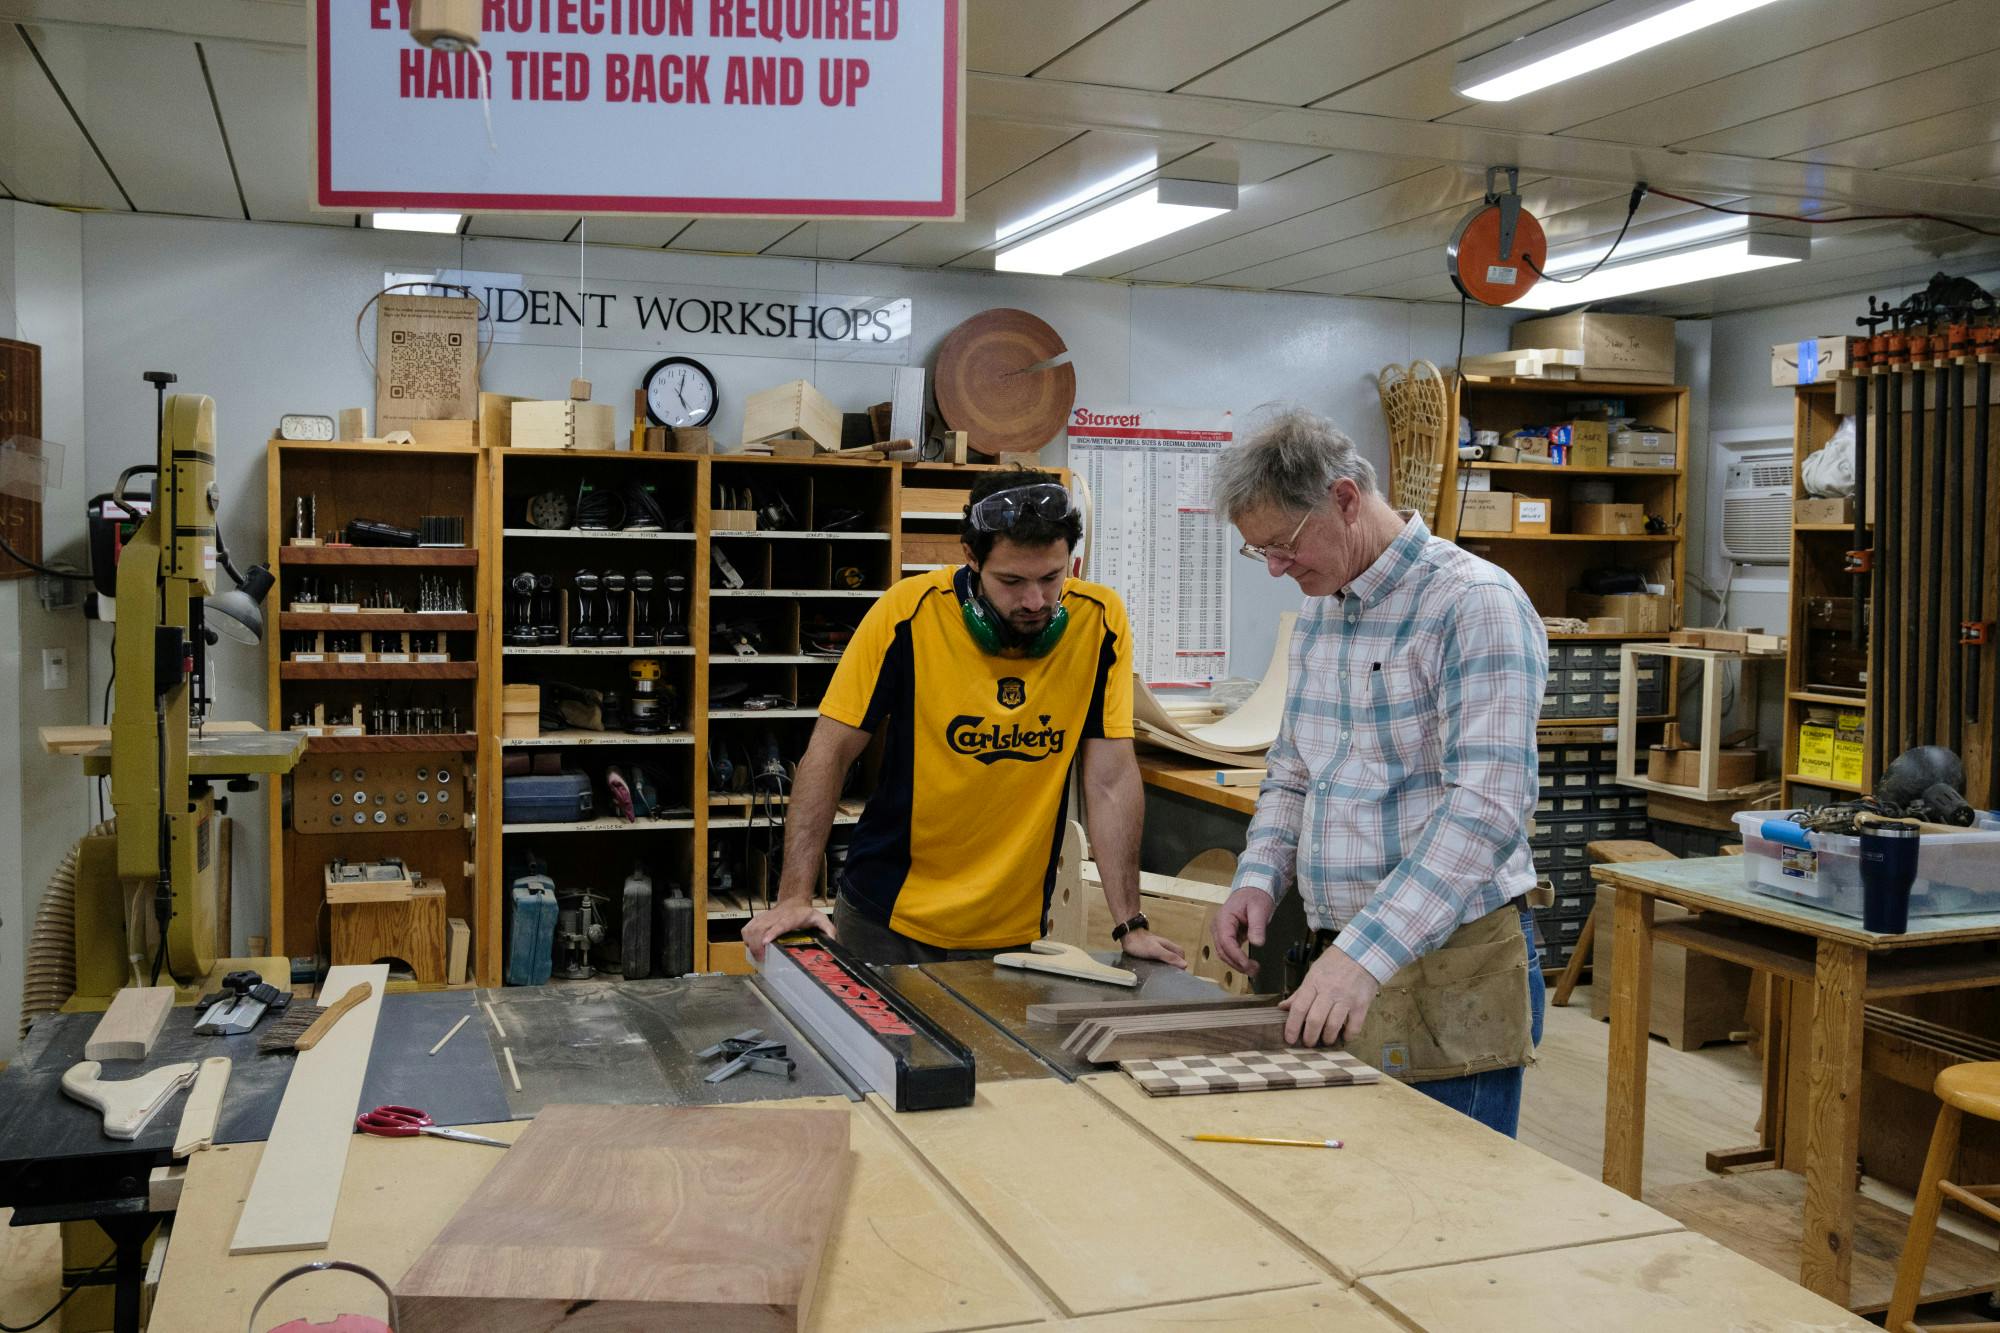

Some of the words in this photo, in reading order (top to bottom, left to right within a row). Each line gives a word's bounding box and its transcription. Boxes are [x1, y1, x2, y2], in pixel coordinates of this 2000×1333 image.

[370, 0, 412, 31] EY
[480, 0, 694, 37] ROTECTION
[709, 0, 899, 43] REQUIRED
[399, 48, 492, 99] HAIR
[506, 51, 590, 102] TIED
[606, 53, 710, 104] BACK
[724, 56, 804, 106] AND
[819, 58, 870, 107] UP
[412, 282, 617, 328] UDENT
[633, 295, 893, 343] WORKSHOPS
[1075, 408, 1142, 428] Starrett
[1162, 440, 1186, 448] DECIMAL
[945, 714, 1067, 757] Carlsberg
